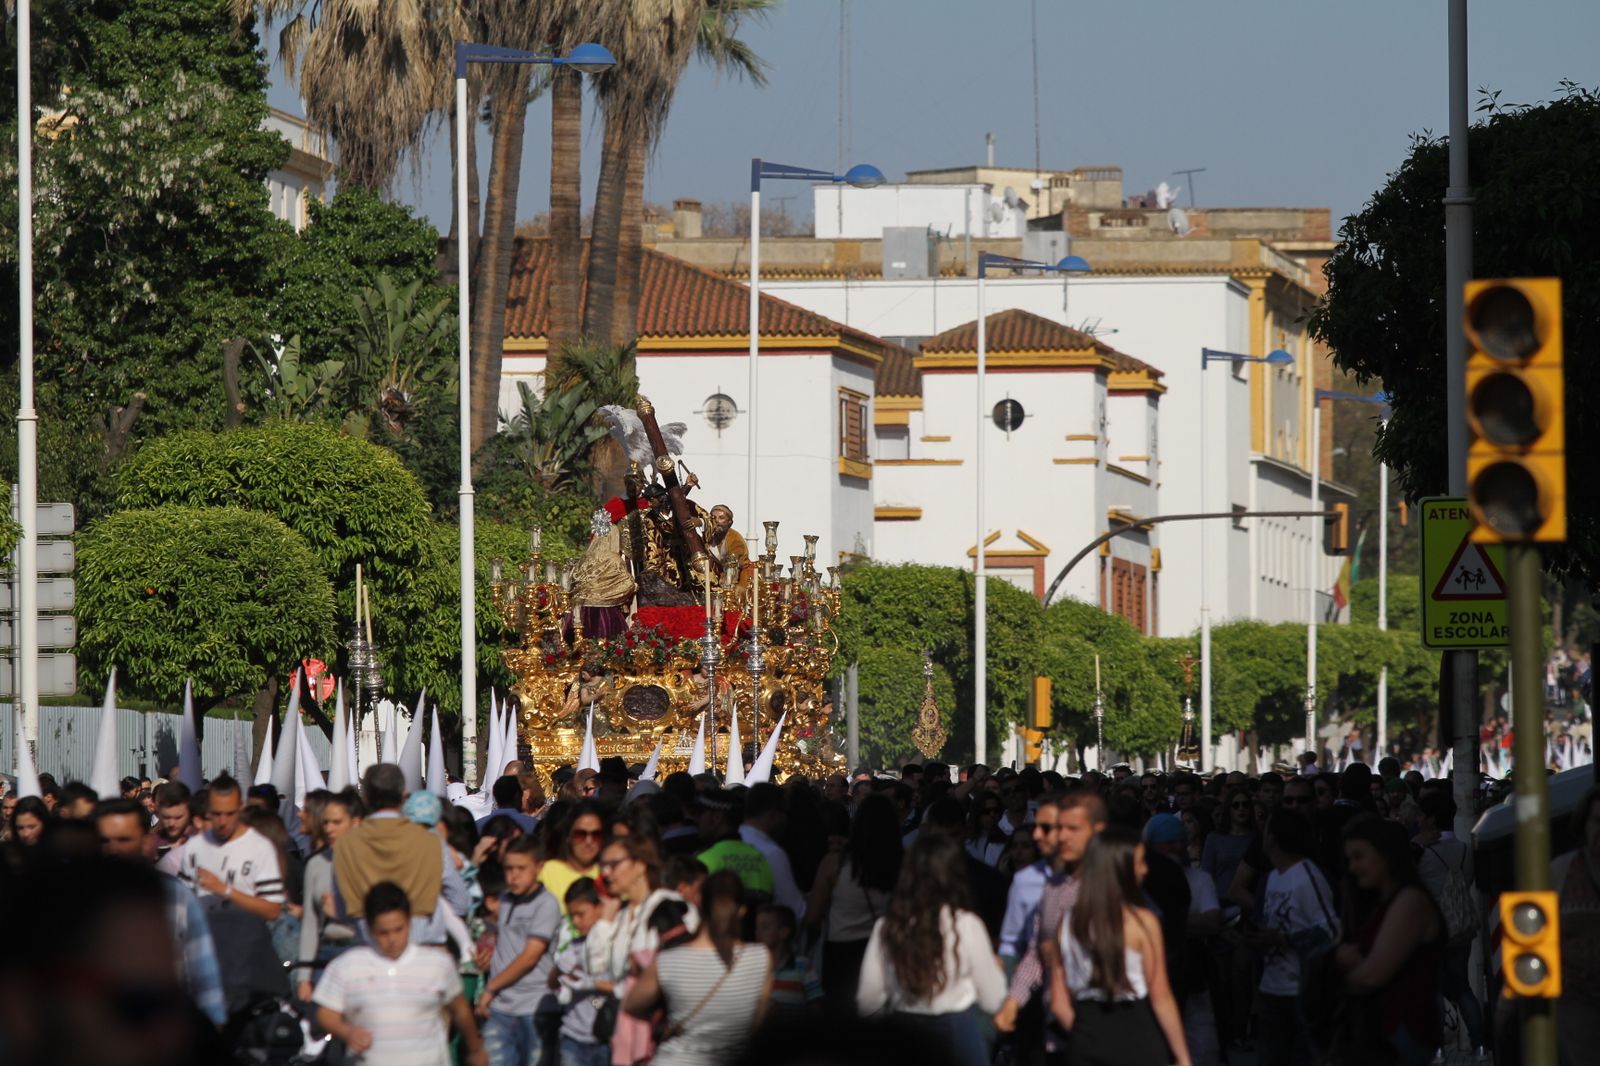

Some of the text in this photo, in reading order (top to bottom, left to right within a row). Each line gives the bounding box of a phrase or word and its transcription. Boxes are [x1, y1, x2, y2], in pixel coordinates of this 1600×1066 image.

[1428, 508, 1470, 520] ATEN
[1450, 612, 1494, 624] ZONA
[1434, 626, 1511, 639] ESCOLAR
